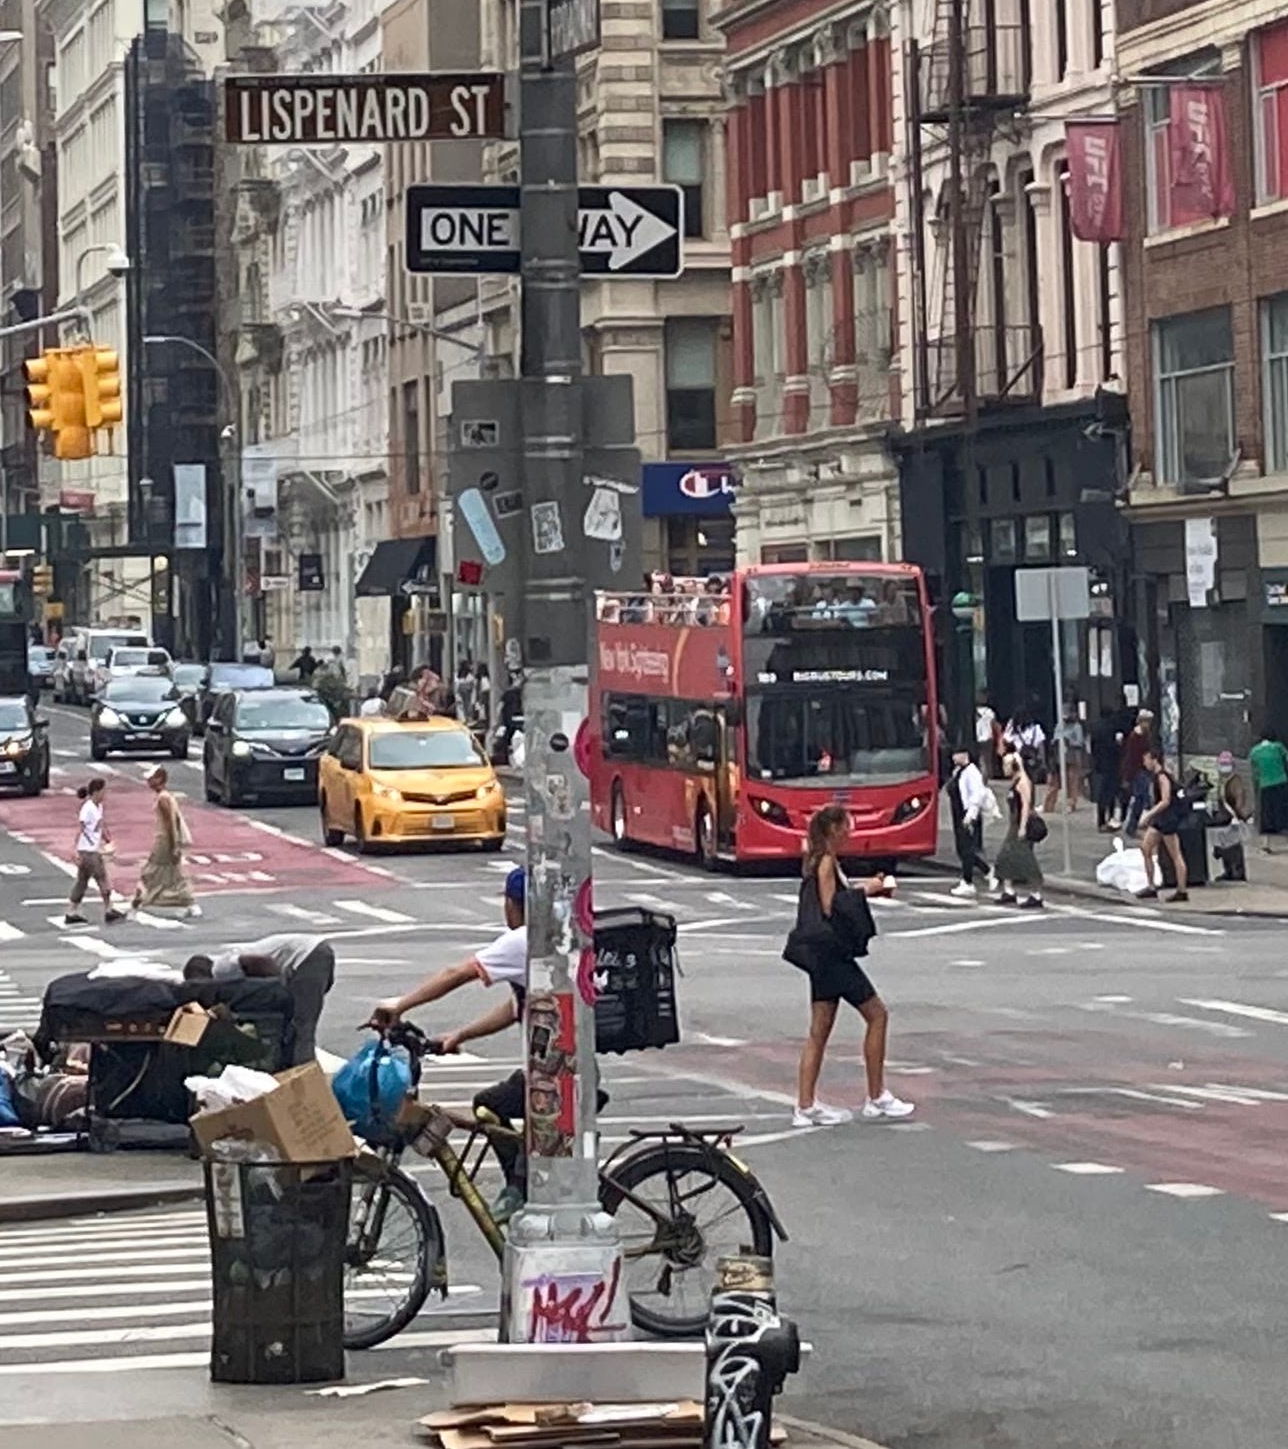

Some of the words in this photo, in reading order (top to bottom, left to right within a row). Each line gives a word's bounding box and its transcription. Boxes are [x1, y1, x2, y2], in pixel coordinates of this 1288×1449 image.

[239, 87, 430, 141] LISPENARD
[450, 85, 488, 136] ST
[430, 212, 510, 247] ONE
[579, 214, 644, 248] AY
